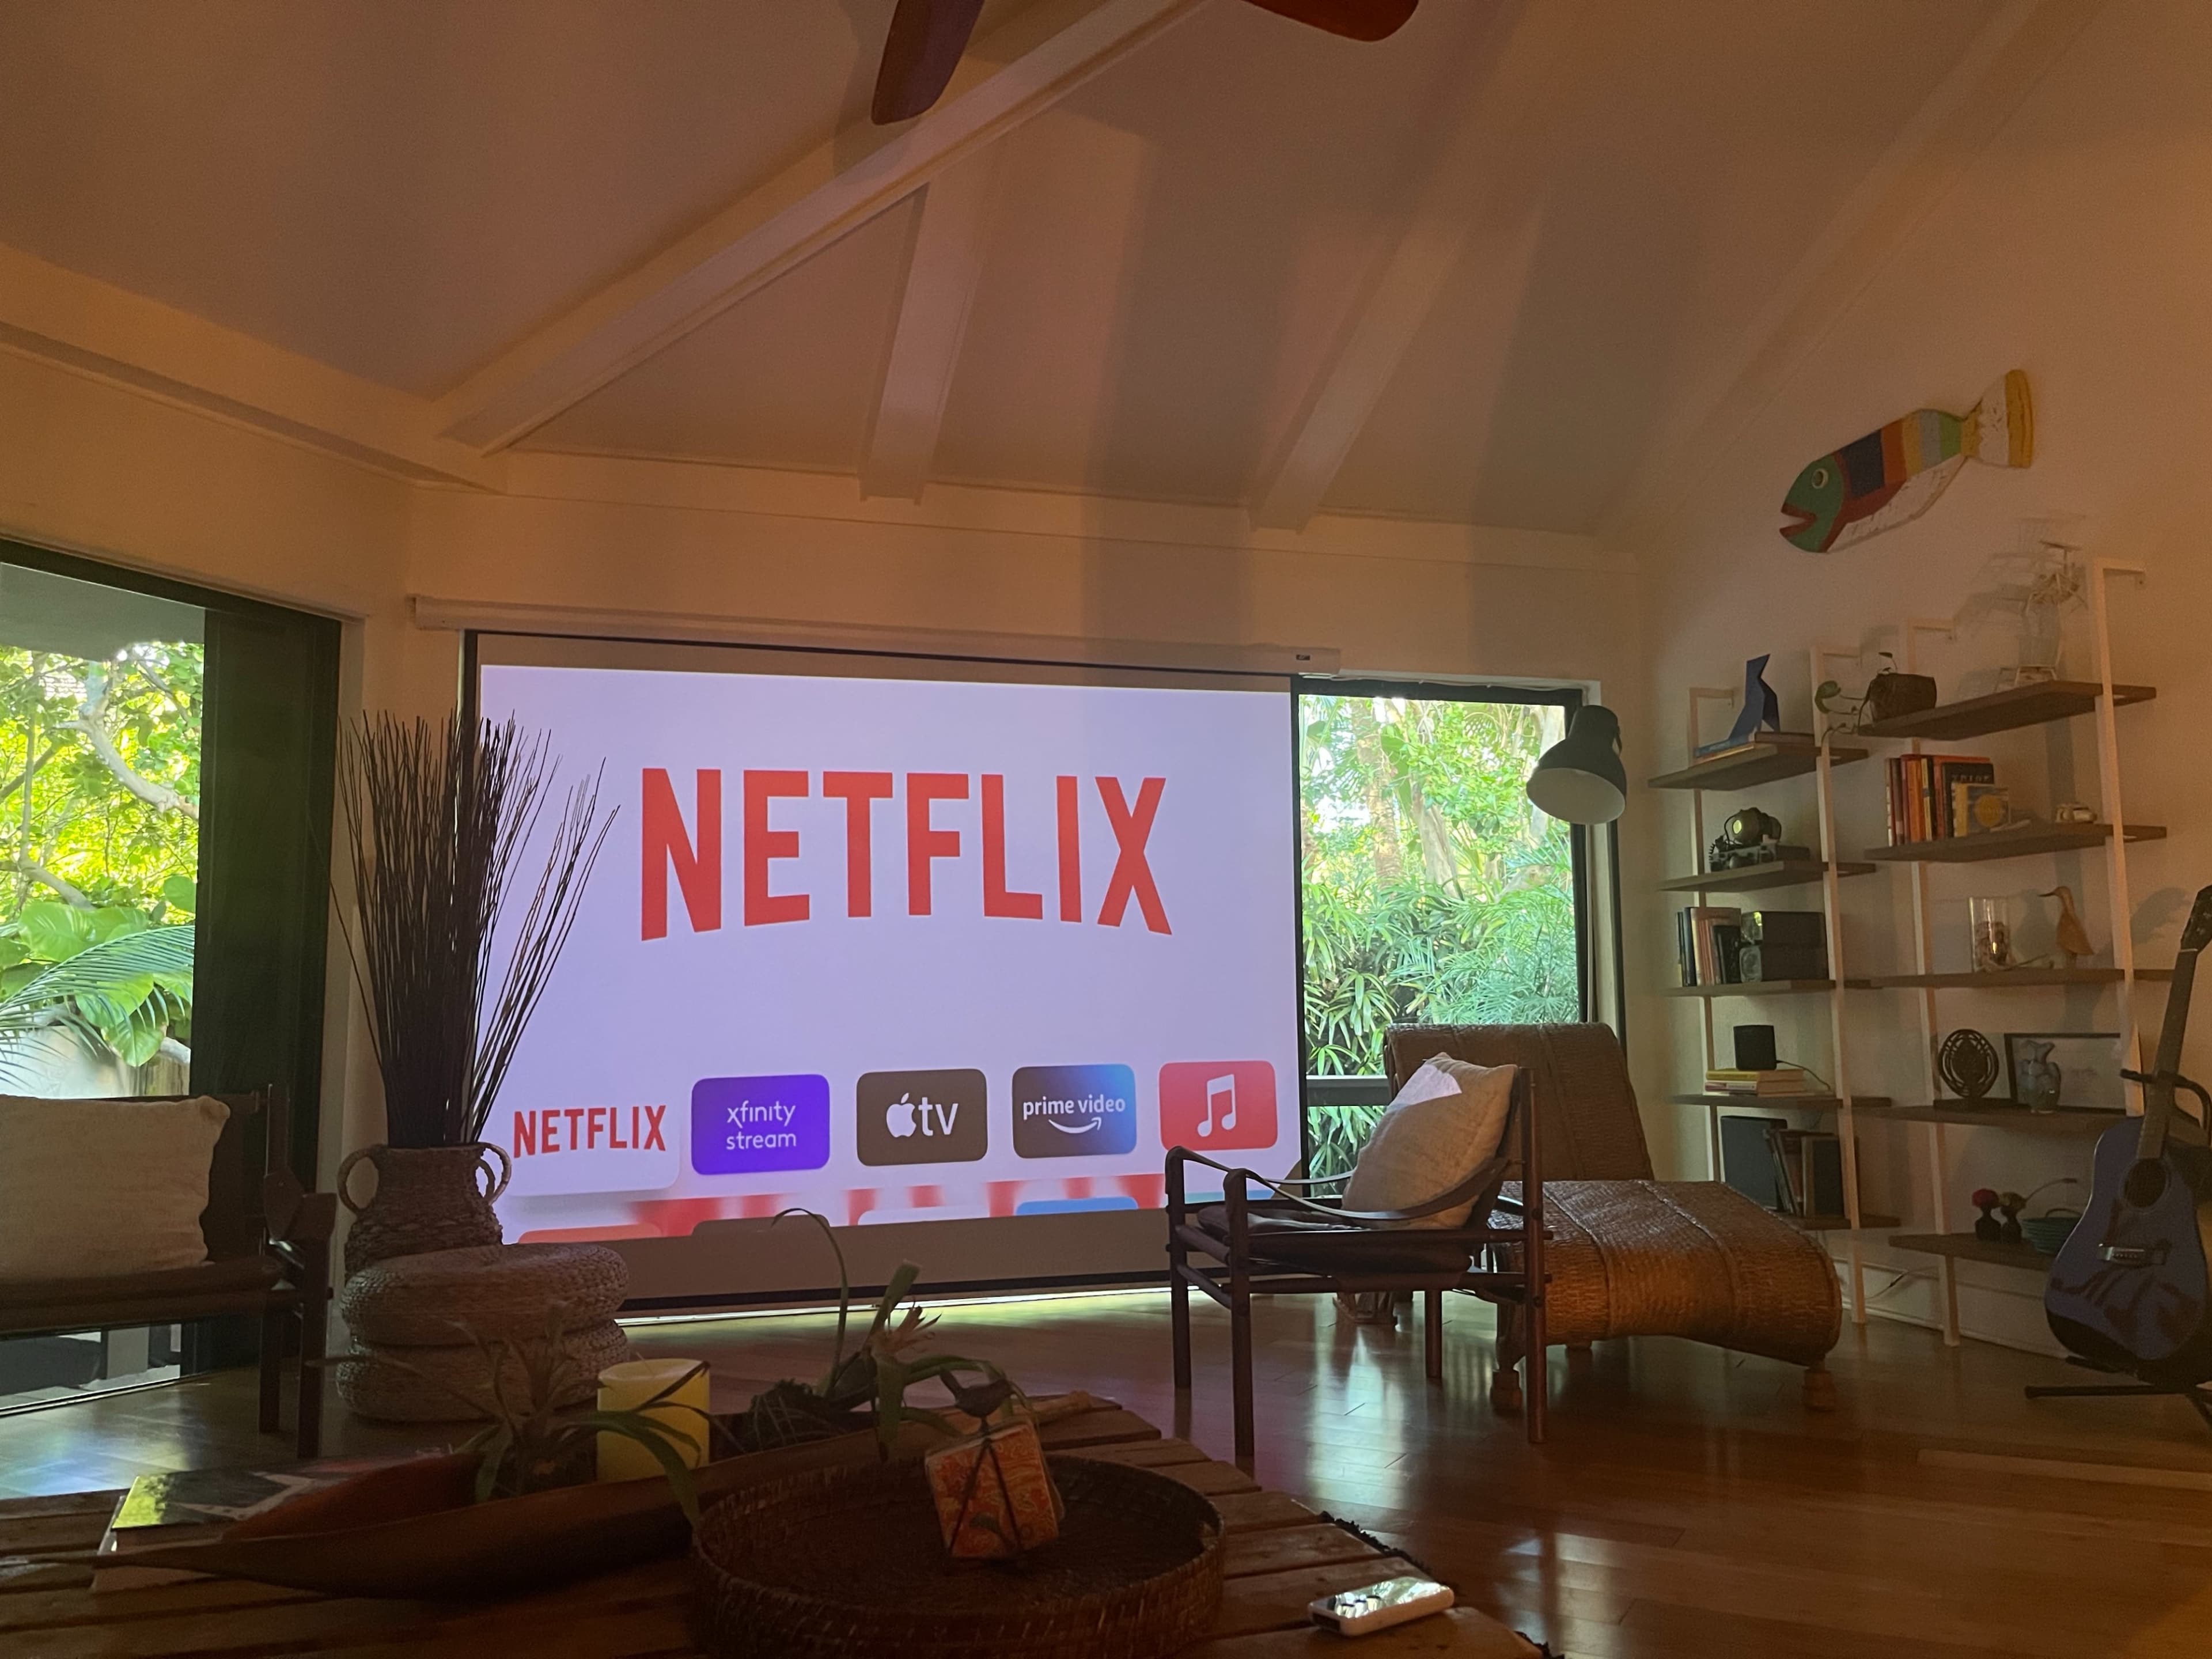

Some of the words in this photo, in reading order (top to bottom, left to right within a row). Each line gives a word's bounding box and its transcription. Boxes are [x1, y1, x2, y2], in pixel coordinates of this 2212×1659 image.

[642, 768, 1172, 941] NETFLIX
[726, 1100, 796, 1128] xfinity
[918, 1096, 959, 1137] tv
[1022, 1095, 1074, 1120] prime
[1077, 1093, 1126, 1114] video
[514, 1105, 666, 1158] NETFLIX
[726, 1131, 797, 1150] stream
